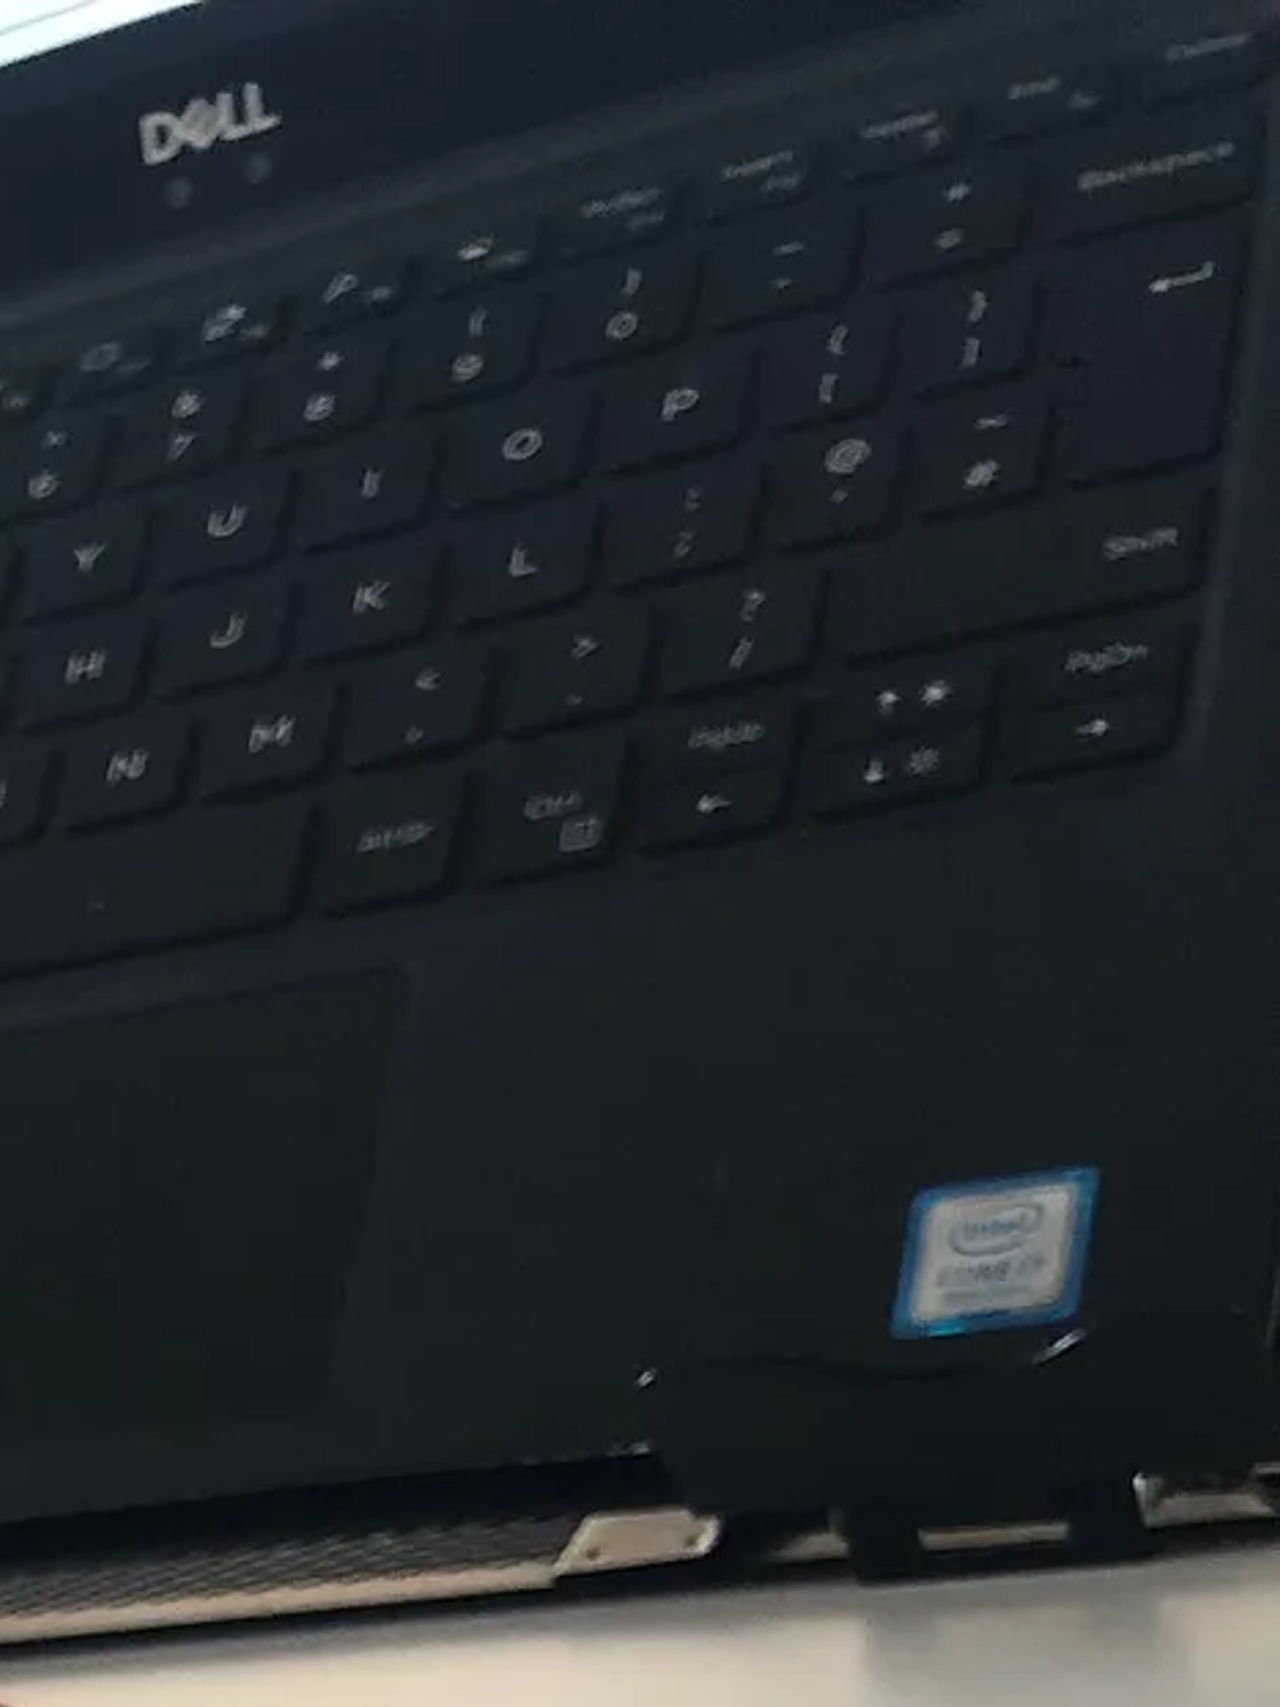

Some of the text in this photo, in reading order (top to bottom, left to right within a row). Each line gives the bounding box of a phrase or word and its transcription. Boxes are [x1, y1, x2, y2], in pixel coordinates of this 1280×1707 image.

[140, 83, 279, 164] DELL
[662, 388, 699, 420] P
[502, 429, 542, 460] O
[825, 439, 871, 473] @
[208, 505, 245, 537] U
[74, 545, 104, 570] Y
[509, 548, 537, 576] L
[354, 582, 389, 612] K
[211, 616, 244, 648] J
[66, 652, 105, 682] H
[249, 717, 293, 752] M
